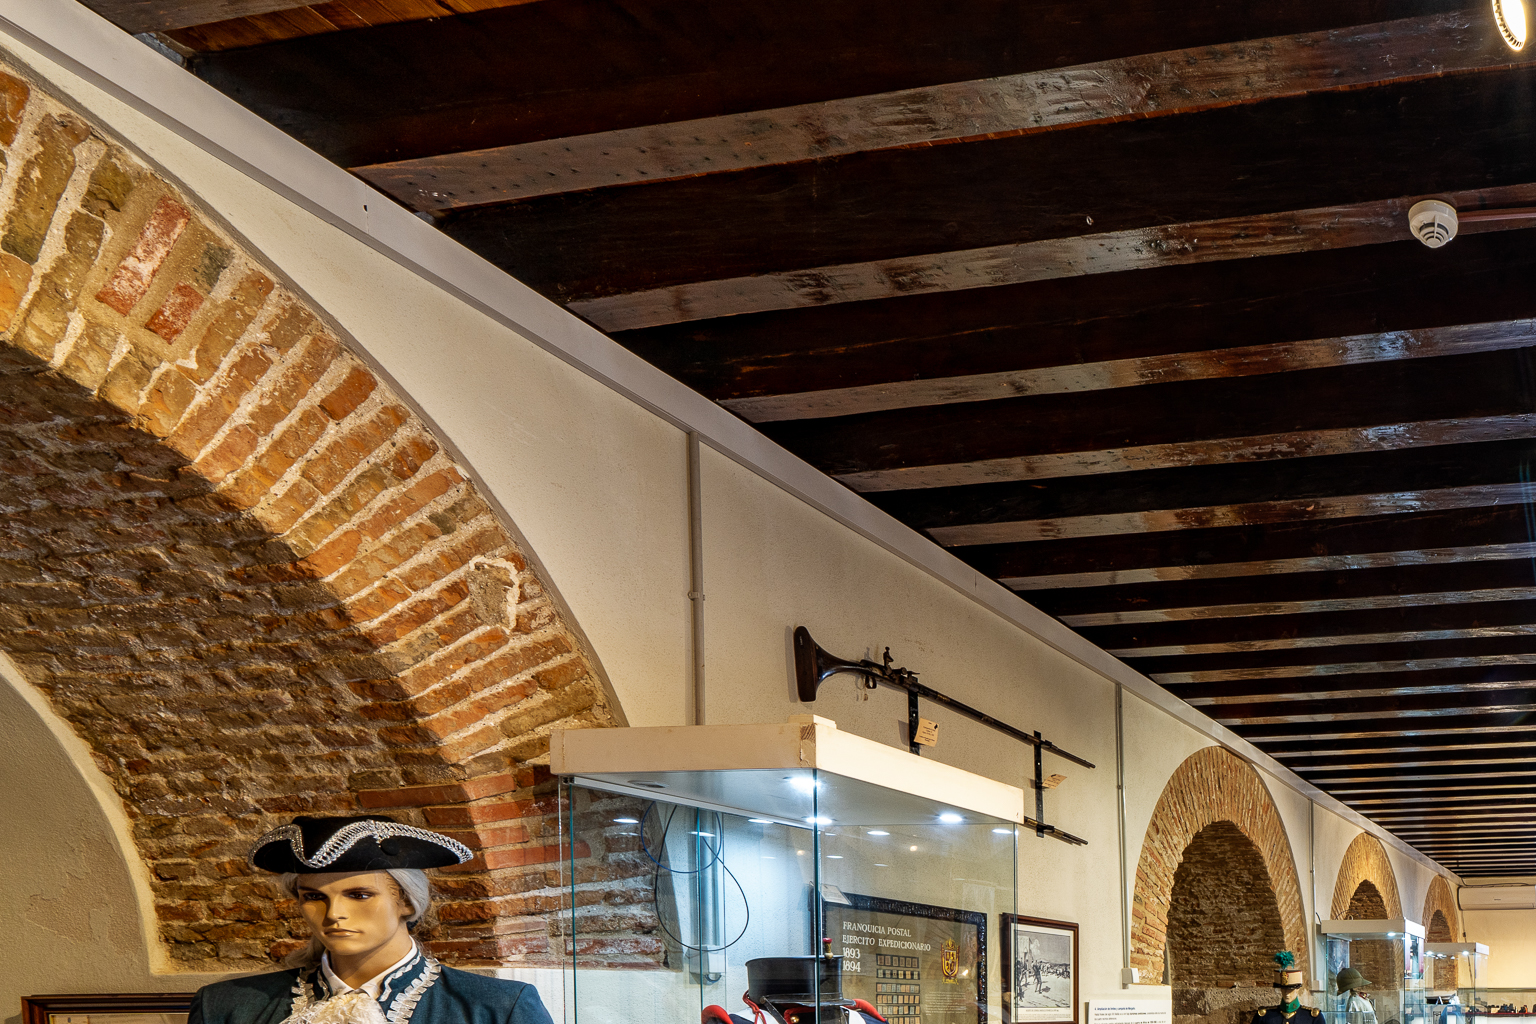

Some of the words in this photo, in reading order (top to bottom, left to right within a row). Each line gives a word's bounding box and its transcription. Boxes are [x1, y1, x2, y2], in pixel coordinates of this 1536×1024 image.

[842, 921, 886, 935] FRANQUICIA
[887, 926, 912, 938] POSTAL
[842, 934, 876, 947] EJERCITO
[878, 938, 932, 953] EXPEDICIONARIO
[842, 947, 861, 960] 1893
[842, 960, 862, 973] 1894
